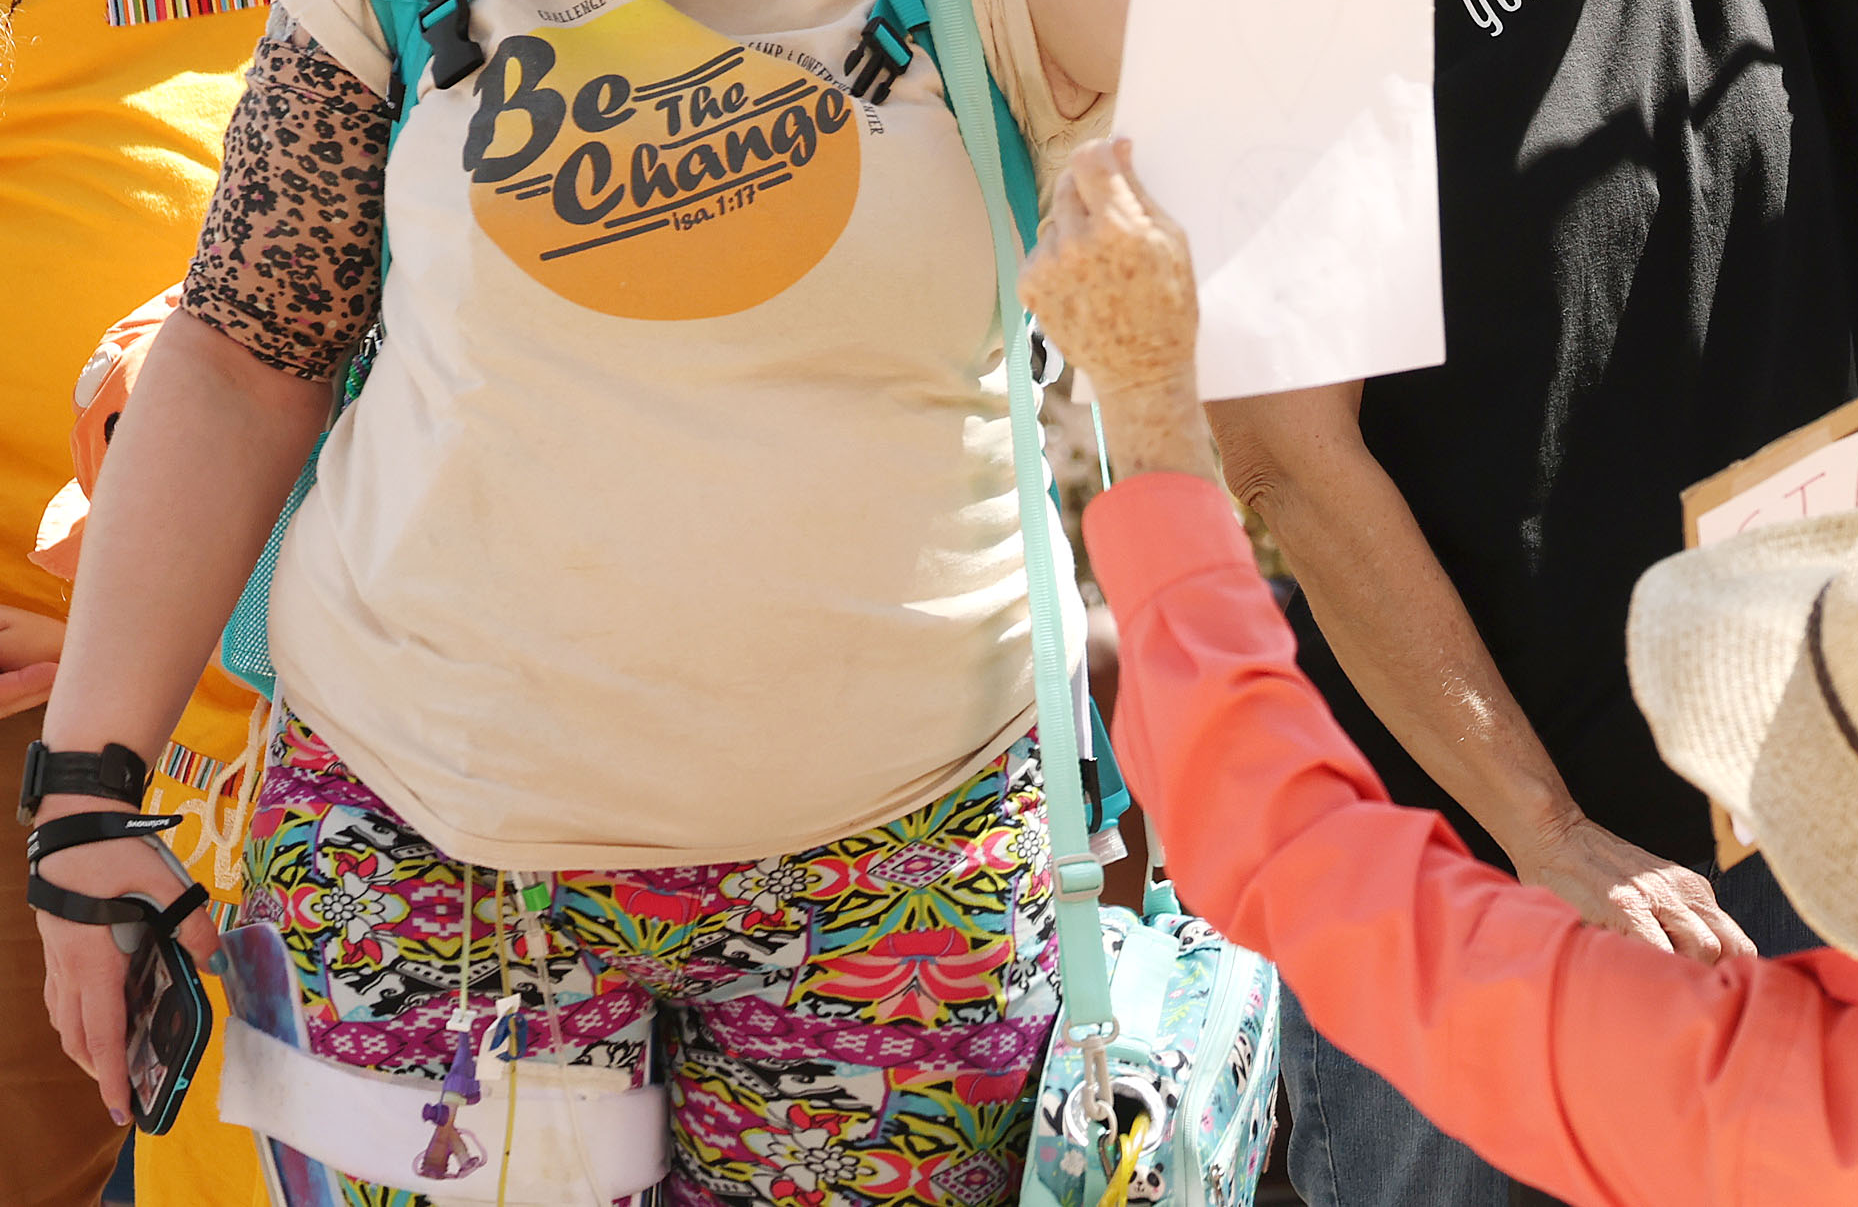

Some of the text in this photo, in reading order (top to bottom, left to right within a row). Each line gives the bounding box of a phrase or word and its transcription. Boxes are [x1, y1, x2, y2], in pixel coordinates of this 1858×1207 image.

[462, 34, 749, 184] Be The
[552, 87, 853, 226] Change
[716, 183, 756, 216] 1:17
